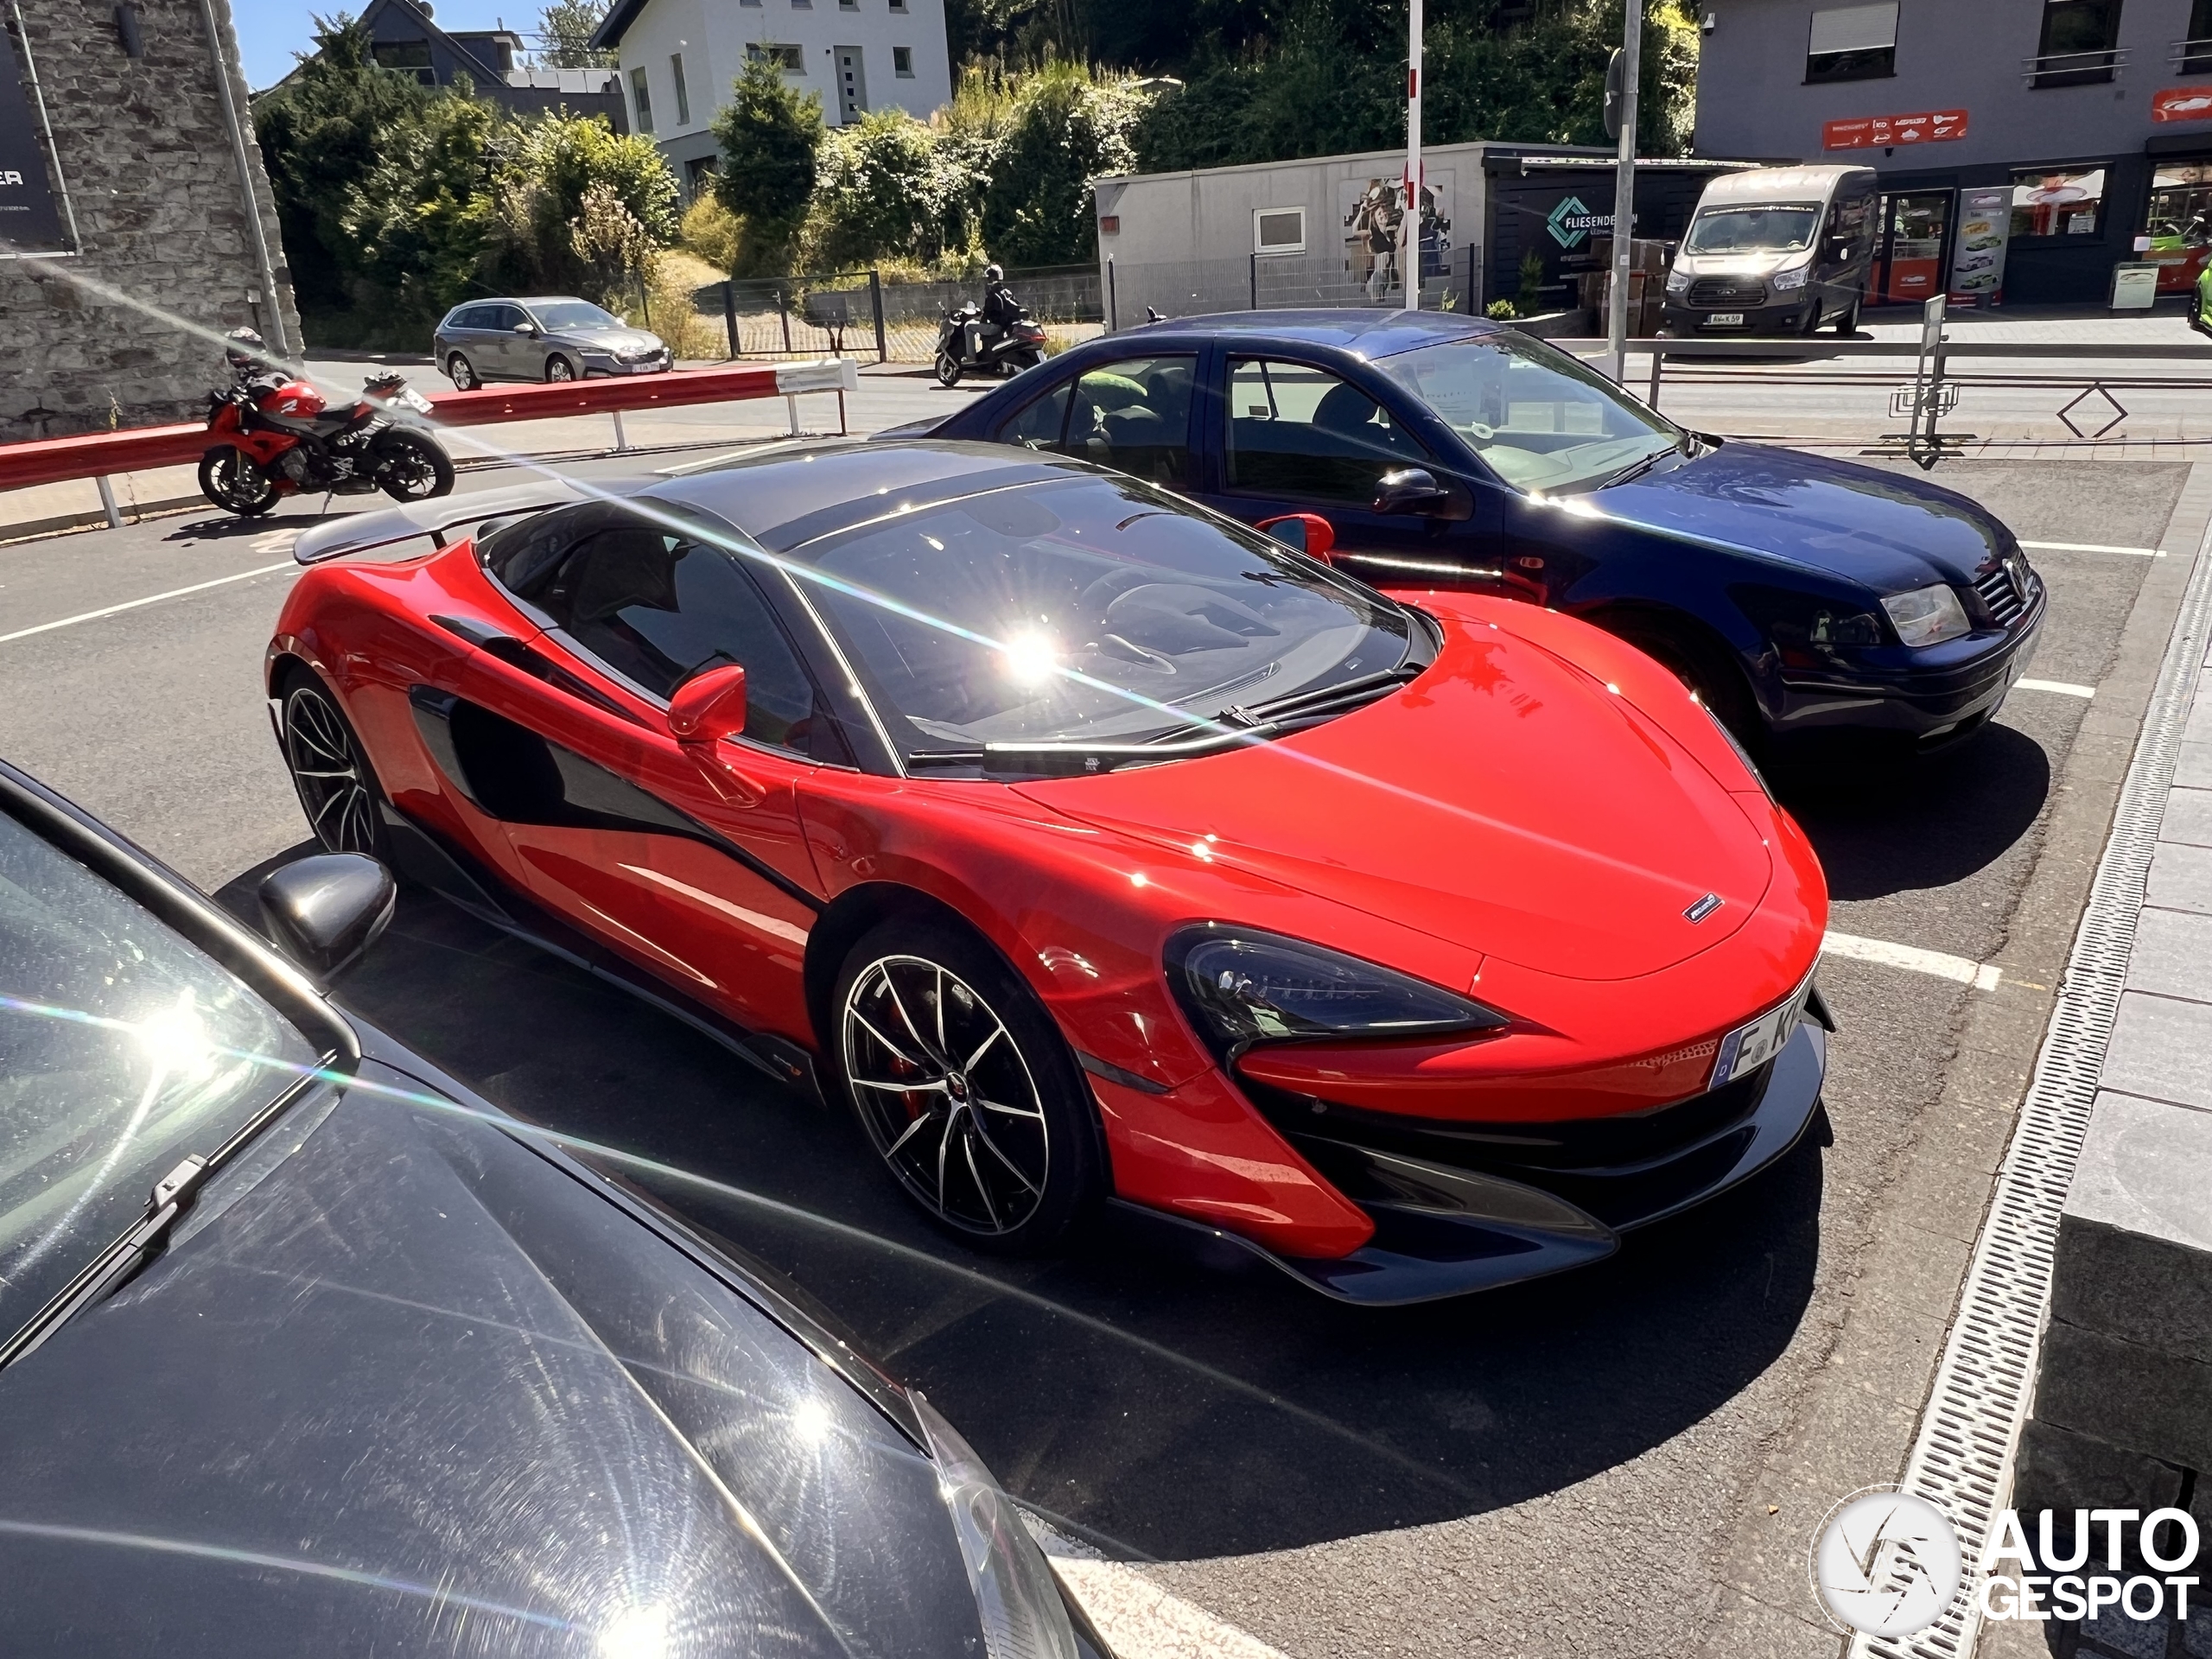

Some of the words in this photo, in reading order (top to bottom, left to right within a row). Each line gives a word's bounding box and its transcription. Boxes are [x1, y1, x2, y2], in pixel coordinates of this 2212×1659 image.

[1566, 213, 1638, 229] FLIESENDEN
[1732, 1027, 1760, 1074] F
[1719, 1064, 1727, 1077] D
